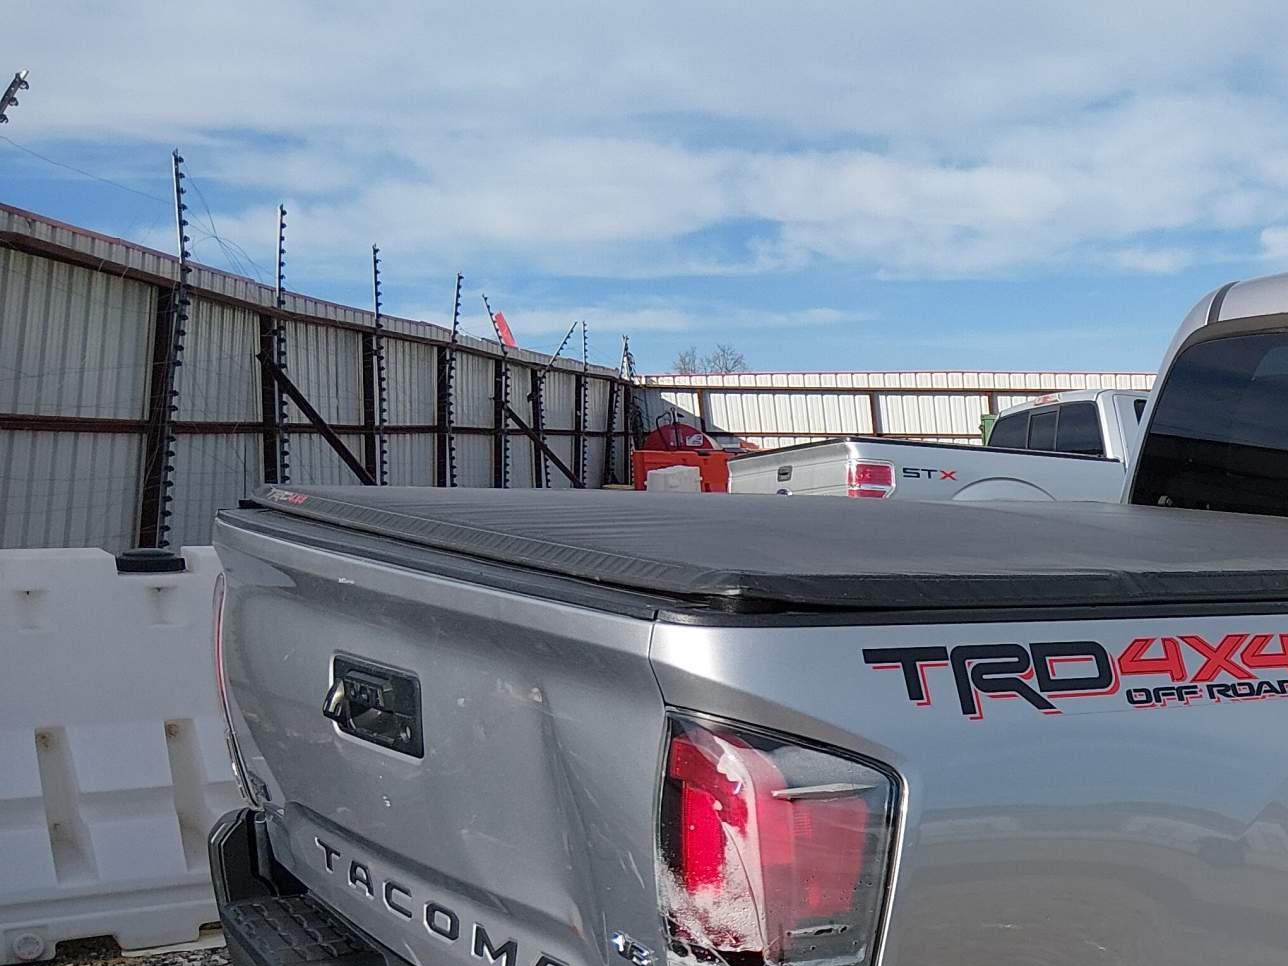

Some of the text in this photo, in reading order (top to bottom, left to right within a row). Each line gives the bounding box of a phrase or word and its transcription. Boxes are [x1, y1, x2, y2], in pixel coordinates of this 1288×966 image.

[902, 467, 957, 481] STX
[862, 641, 1119, 720] TRD
[1126, 684, 1203, 709] OFF
